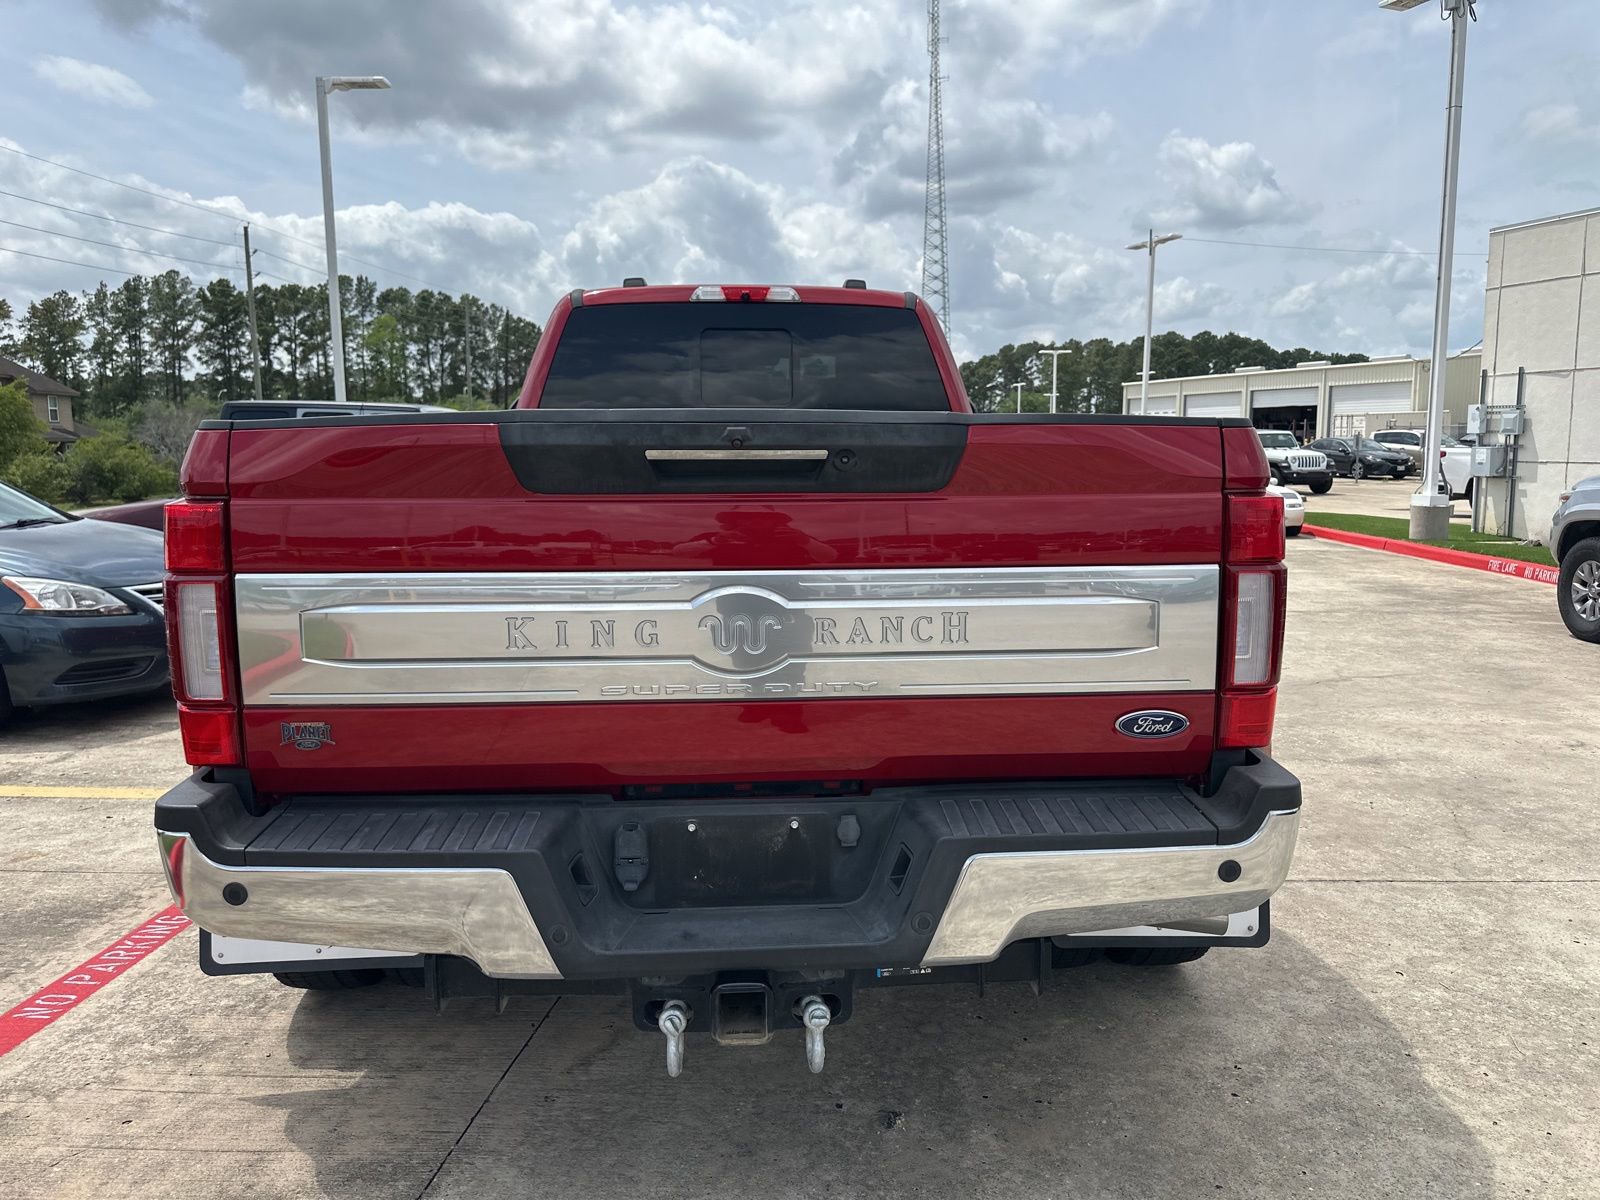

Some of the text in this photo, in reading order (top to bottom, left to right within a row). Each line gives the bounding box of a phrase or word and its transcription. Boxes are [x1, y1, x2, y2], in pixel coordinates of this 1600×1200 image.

[1488, 560, 1501, 572] FIRE
[1502, 562, 1518, 574] LANE
[1524, 566, 1533, 578] NO
[505, 611, 969, 650] KING RANCH
[601, 681, 878, 696] SUPER DUTY
[280, 722, 331, 742] PLANET
[1133, 716, 1174, 733] Ford
[12, 915, 190, 1019] NO PARKING
